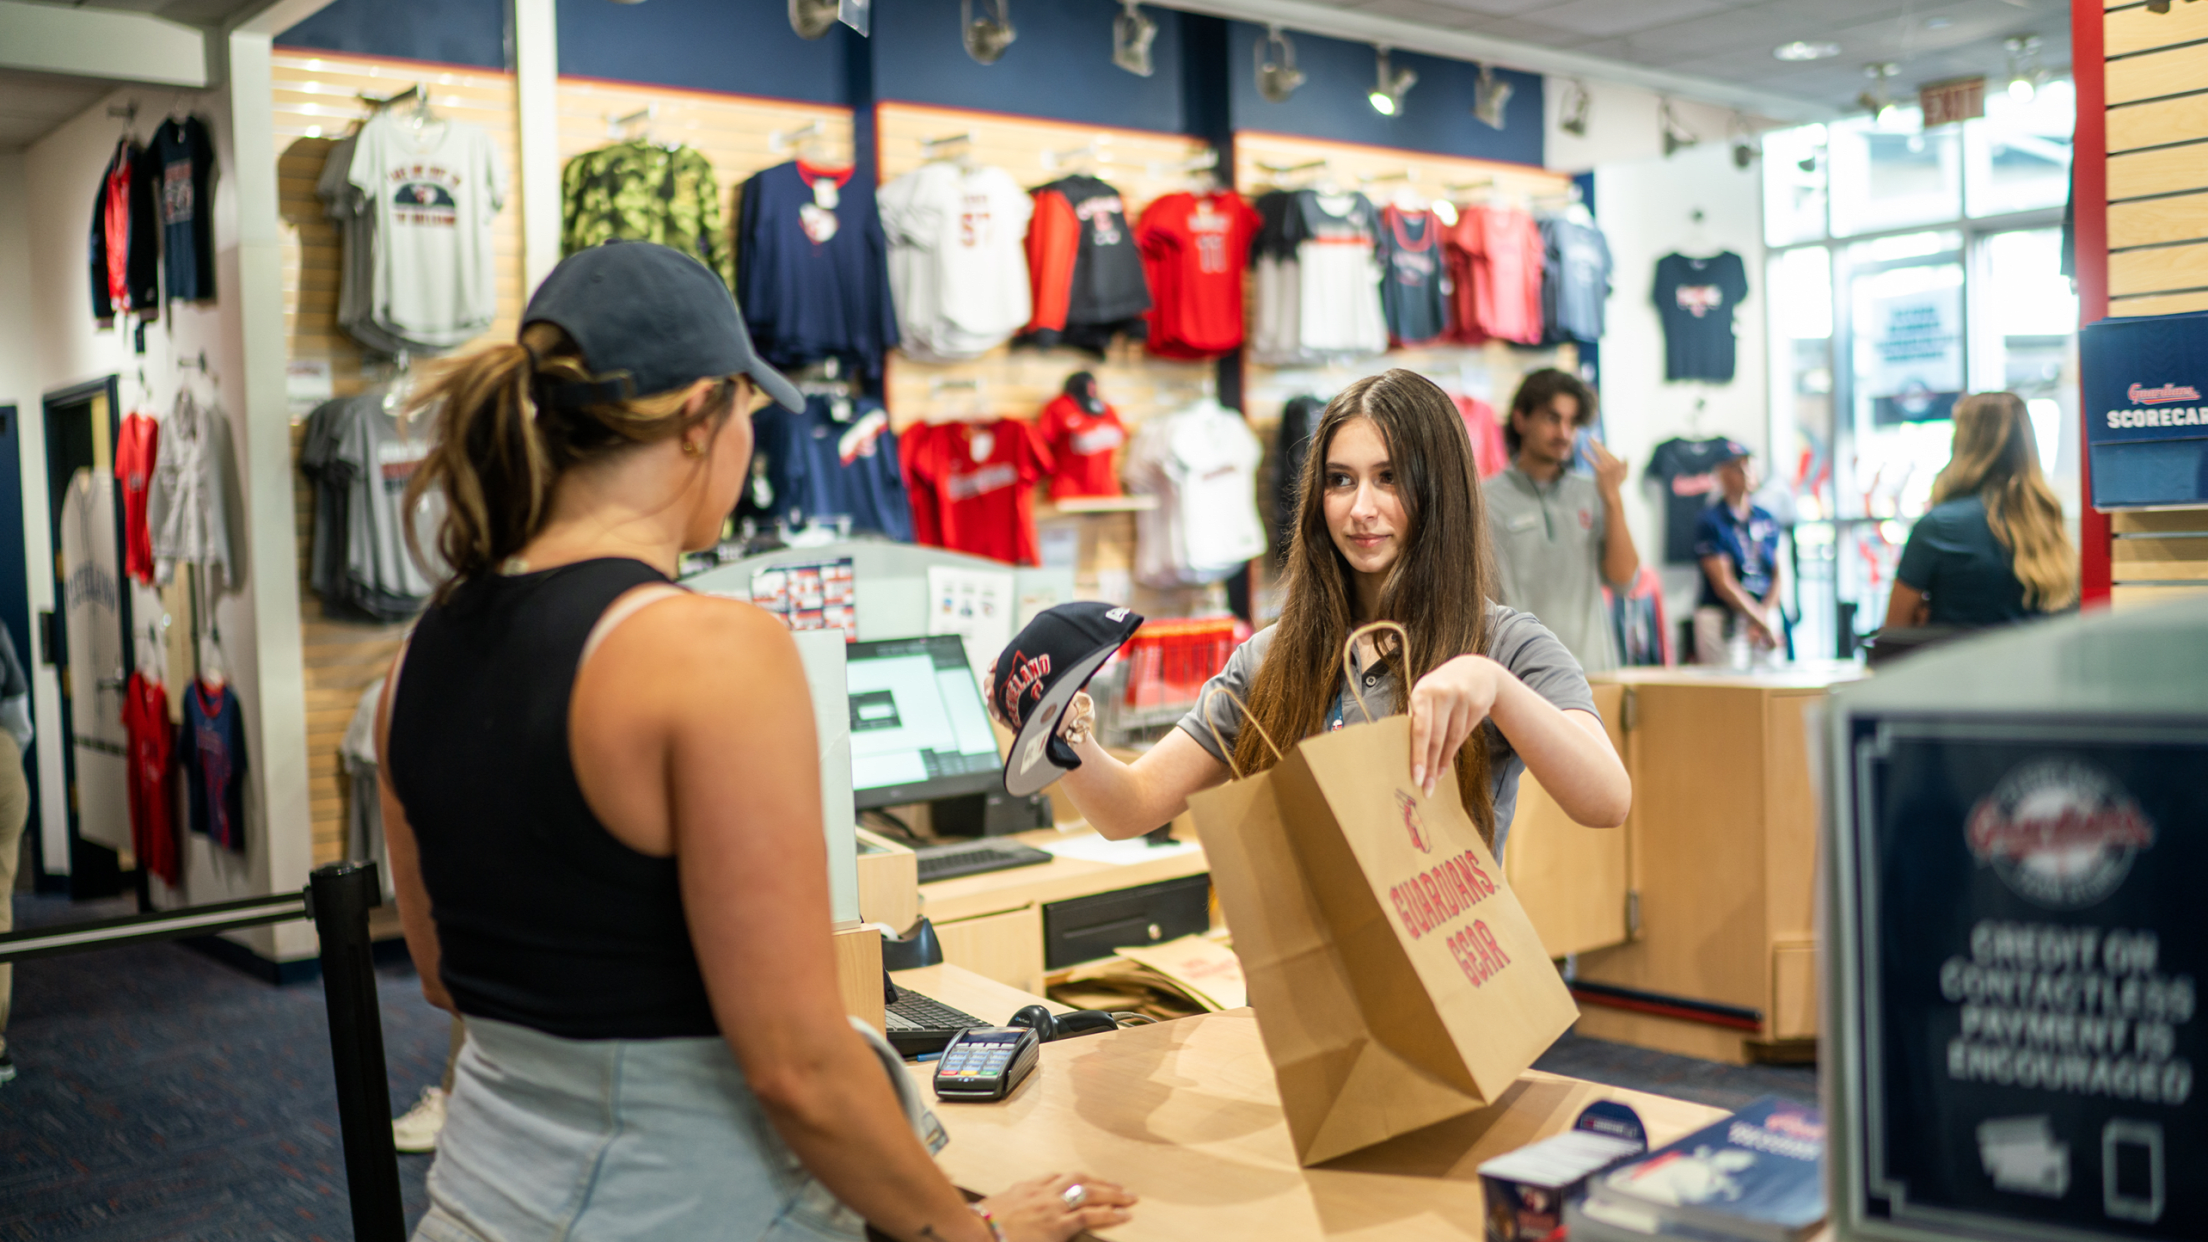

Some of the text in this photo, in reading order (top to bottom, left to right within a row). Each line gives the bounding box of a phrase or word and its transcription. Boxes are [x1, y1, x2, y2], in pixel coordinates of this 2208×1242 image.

[1389, 849, 1496, 940] GUARDIANS
[1446, 918, 1512, 989] GEAR
[1971, 919, 2160, 976] CREDIT OR
[1939, 956, 2197, 1024] CONTACTLESS
[1960, 1003, 2127, 1056] PAYMENT
[1947, 1037, 2193, 1106] ENCOURAGED
